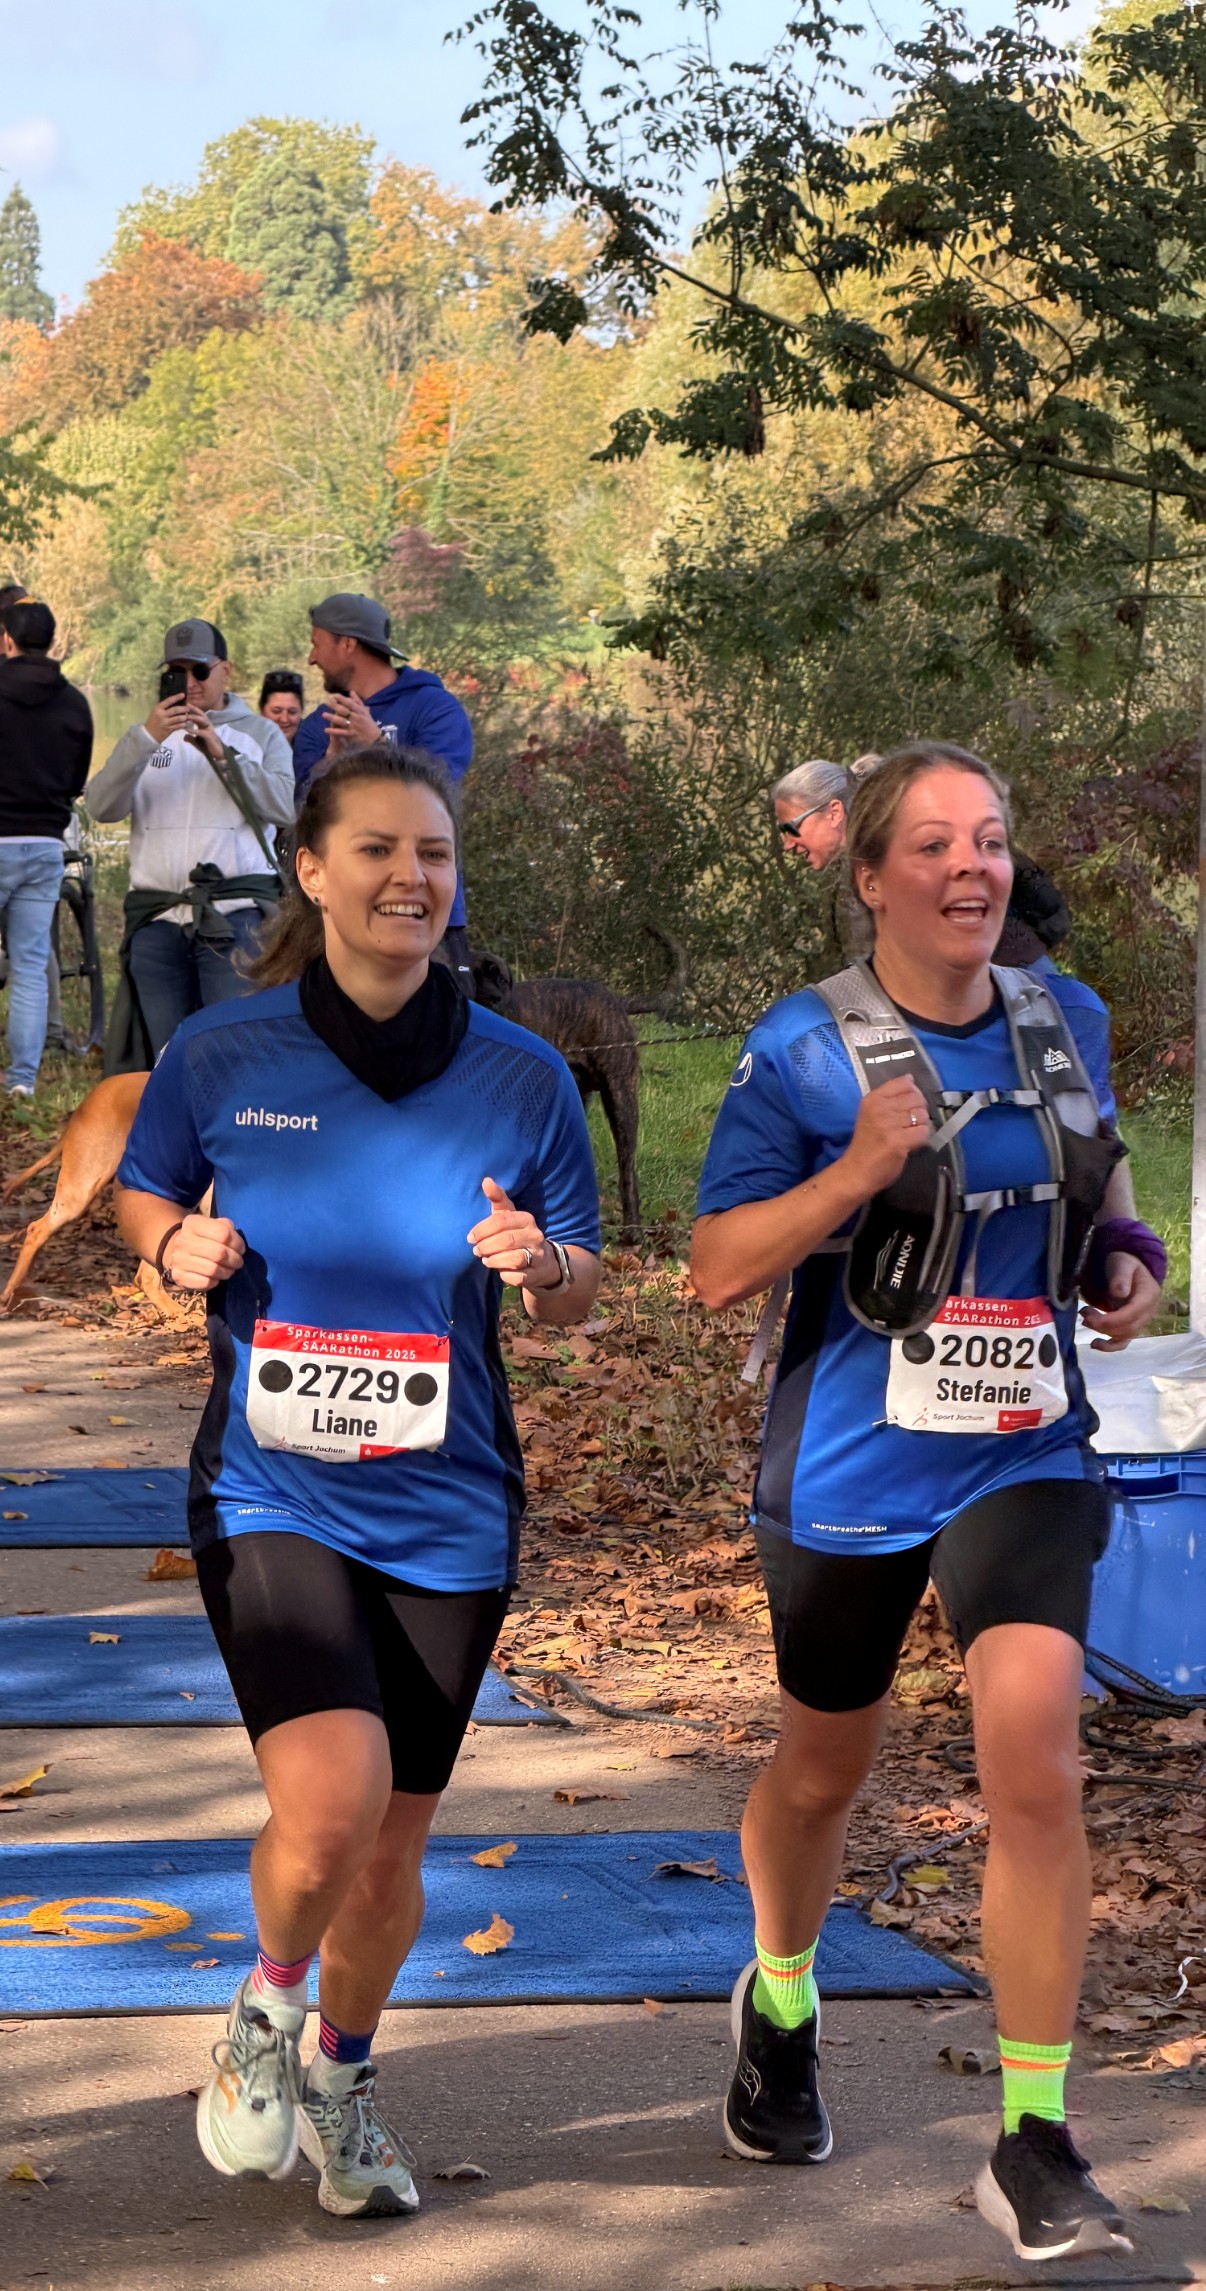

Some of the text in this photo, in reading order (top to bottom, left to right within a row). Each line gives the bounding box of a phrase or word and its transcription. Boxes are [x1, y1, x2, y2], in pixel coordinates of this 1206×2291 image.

[235, 1107, 318, 1131] uhlsport
[945, 1299, 1014, 1313] arkassen-
[944, 1312, 1019, 1326] SAARathon
[287, 1326, 374, 1344] Sparkassen-
[302, 1341, 416, 1361] SAARathon 2025
[939, 1334, 1034, 1369] 2082
[297, 1363, 400, 1404] 2729
[936, 1378, 1031, 1404] Stefanie
[312, 1408, 378, 1438] Liane
[933, 1413, 954, 1421] Sport
[291, 1443, 346, 1455] Sport Jochum
